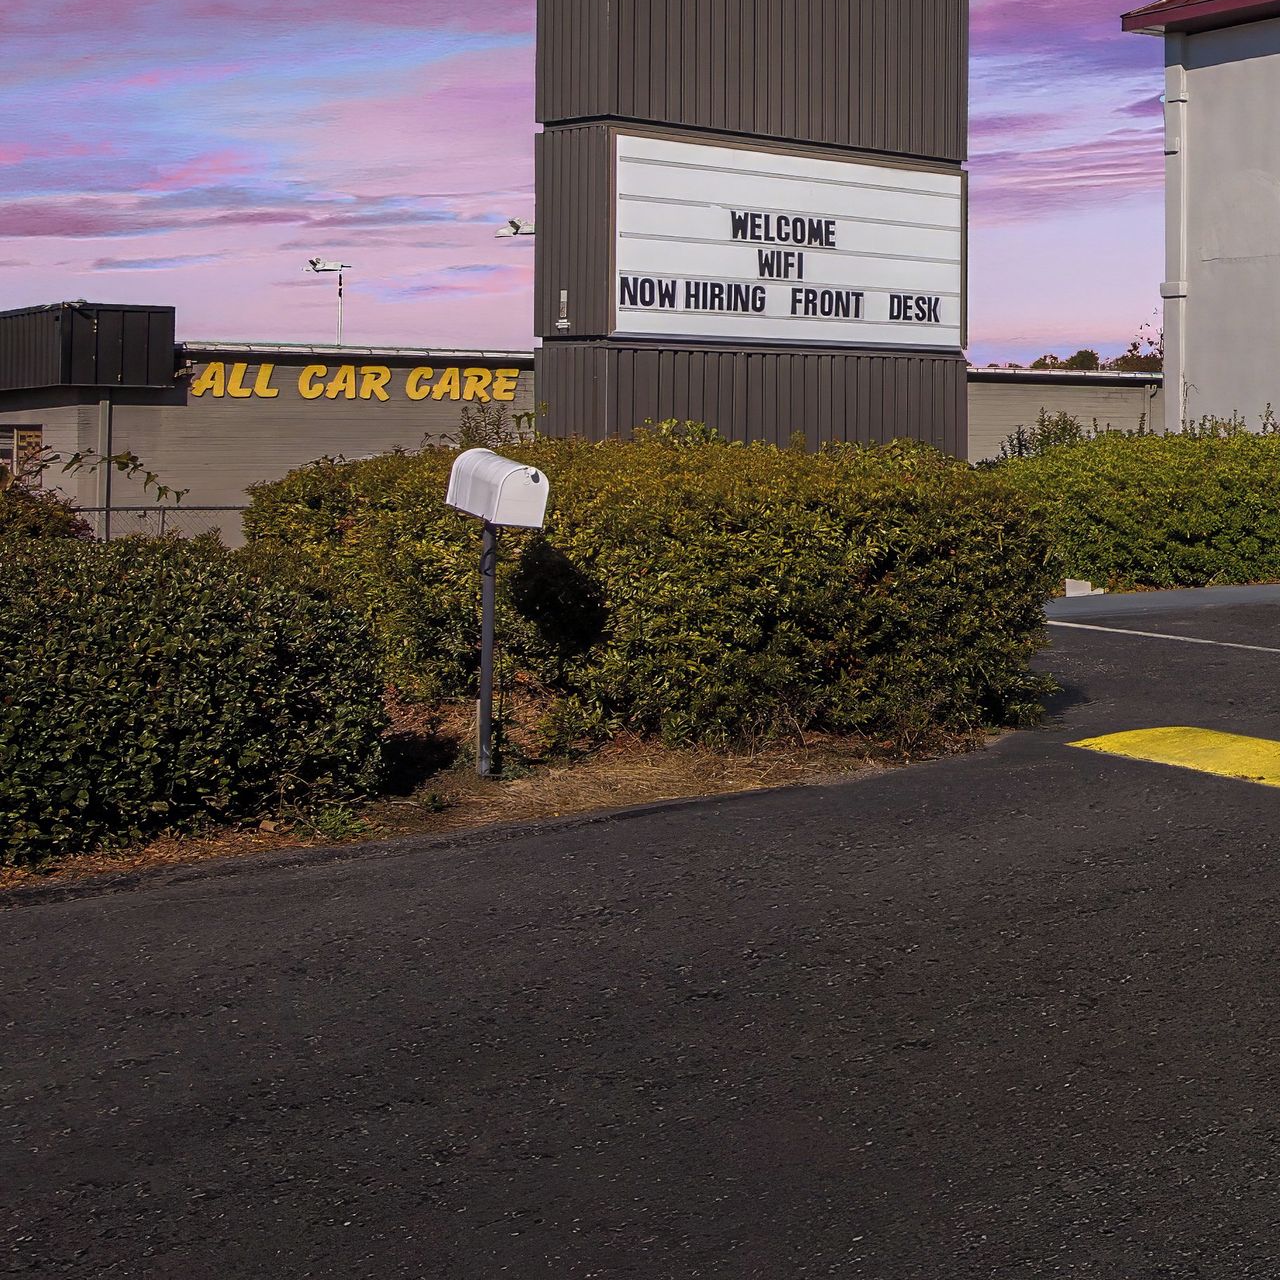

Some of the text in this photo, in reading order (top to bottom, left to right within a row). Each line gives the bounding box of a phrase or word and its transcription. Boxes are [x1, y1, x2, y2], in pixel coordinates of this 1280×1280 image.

[730, 210, 836, 247] WELCOME
[757, 248, 804, 280] WIFI
[619, 276, 940, 323] NOW HIRING FRONT DESK
[191, 361, 519, 402] ALL CAR CARE
